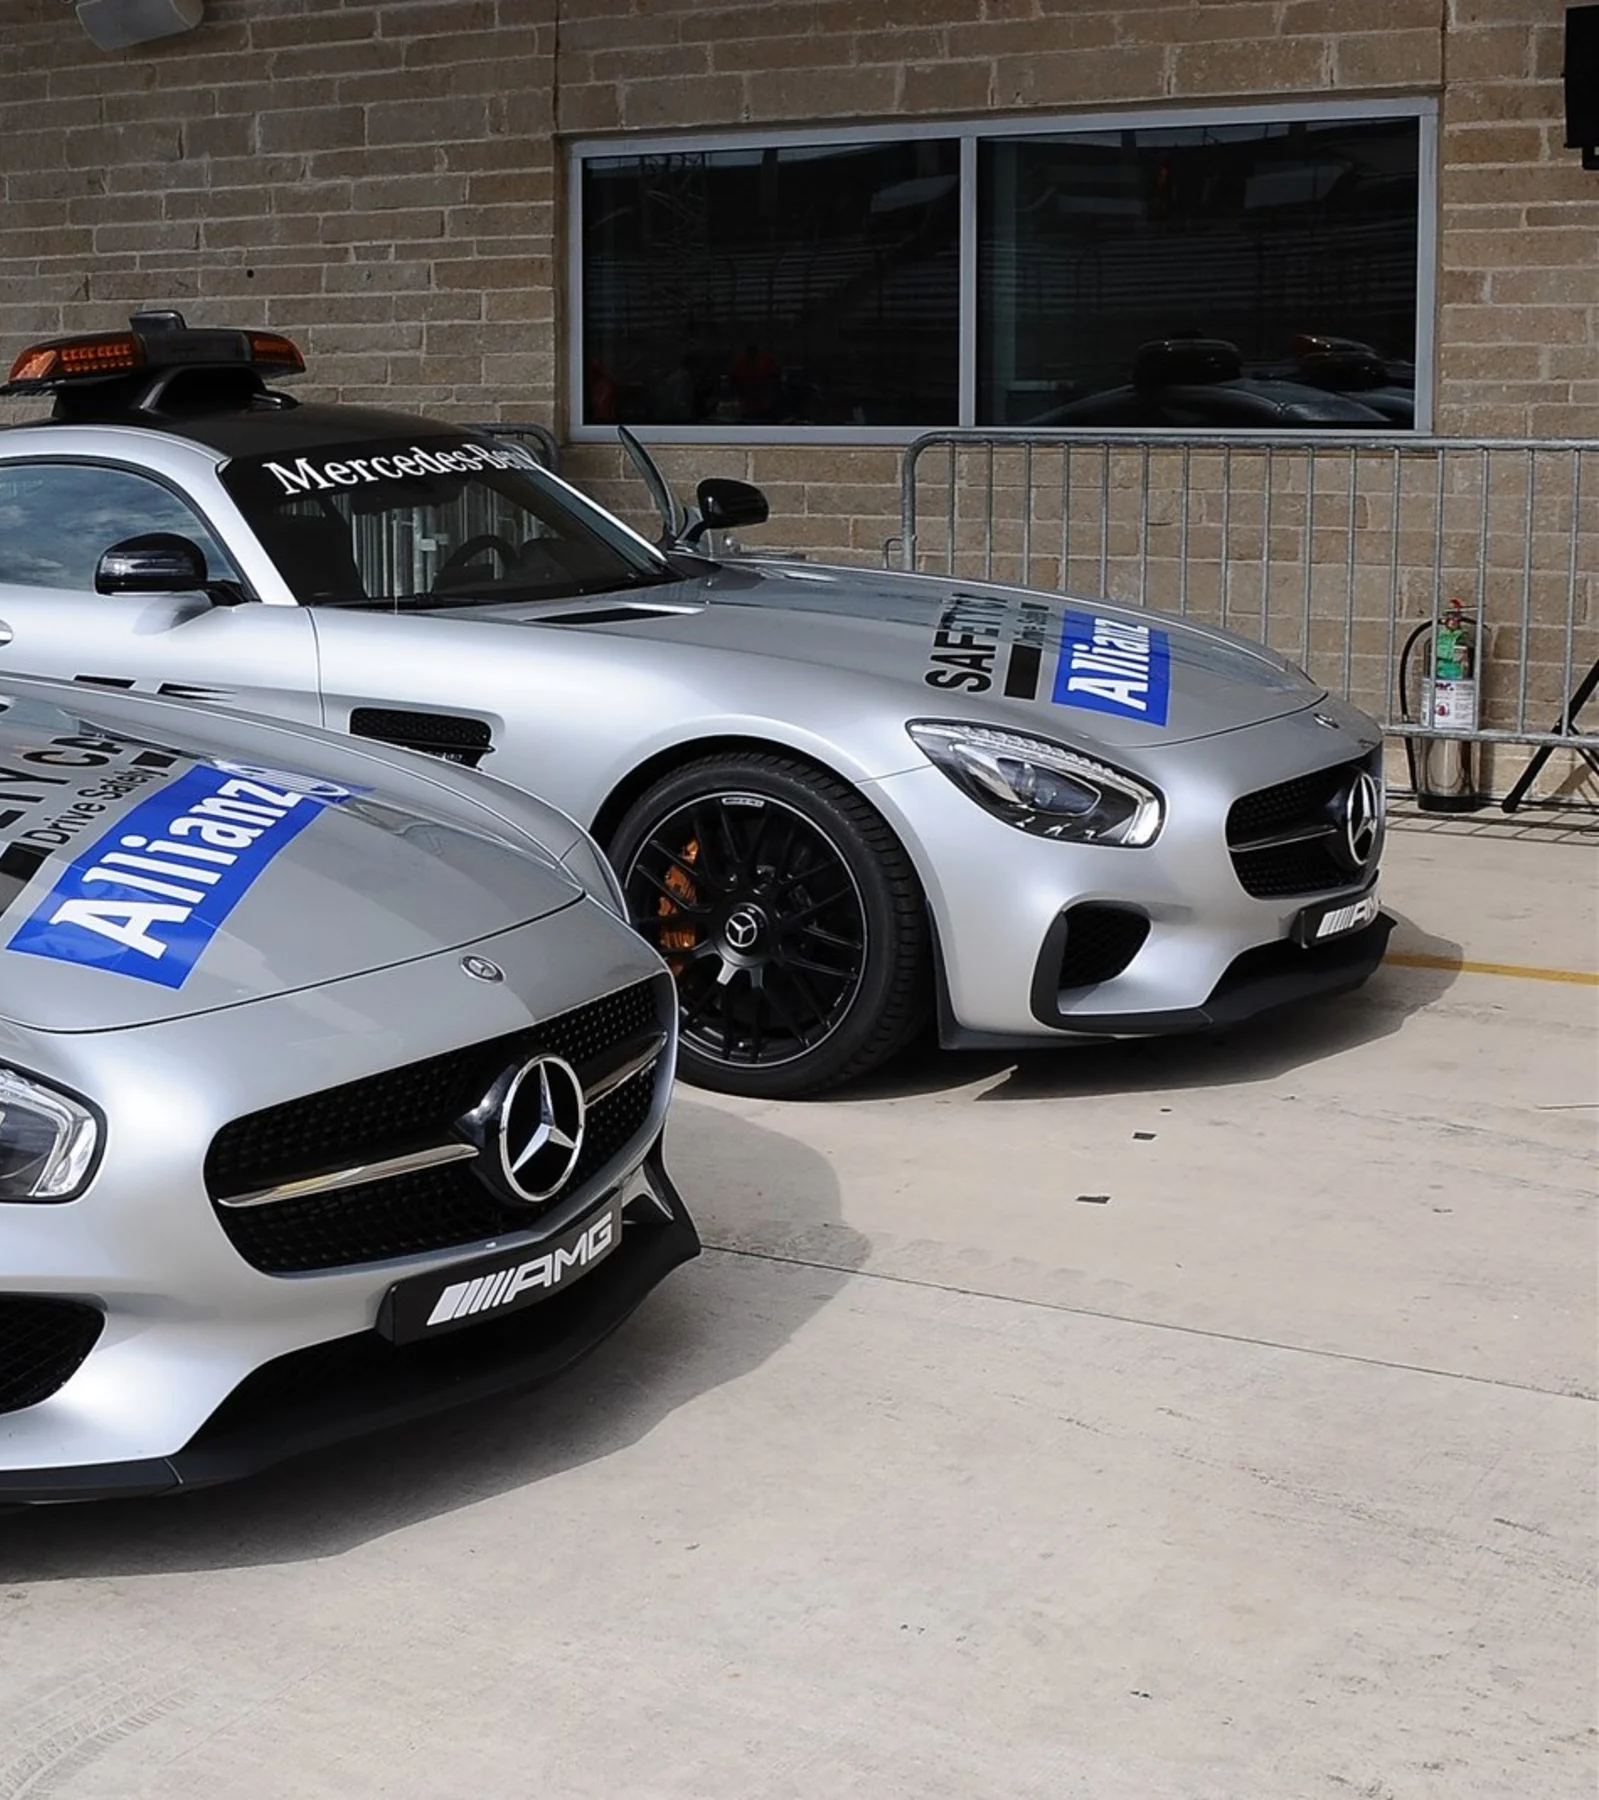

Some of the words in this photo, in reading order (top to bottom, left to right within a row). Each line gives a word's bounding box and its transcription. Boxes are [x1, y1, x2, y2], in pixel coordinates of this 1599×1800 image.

[1067, 617, 1150, 711] Allianz
[21, 803, 106, 845] Drive
[49, 778, 302, 960] Allianz
